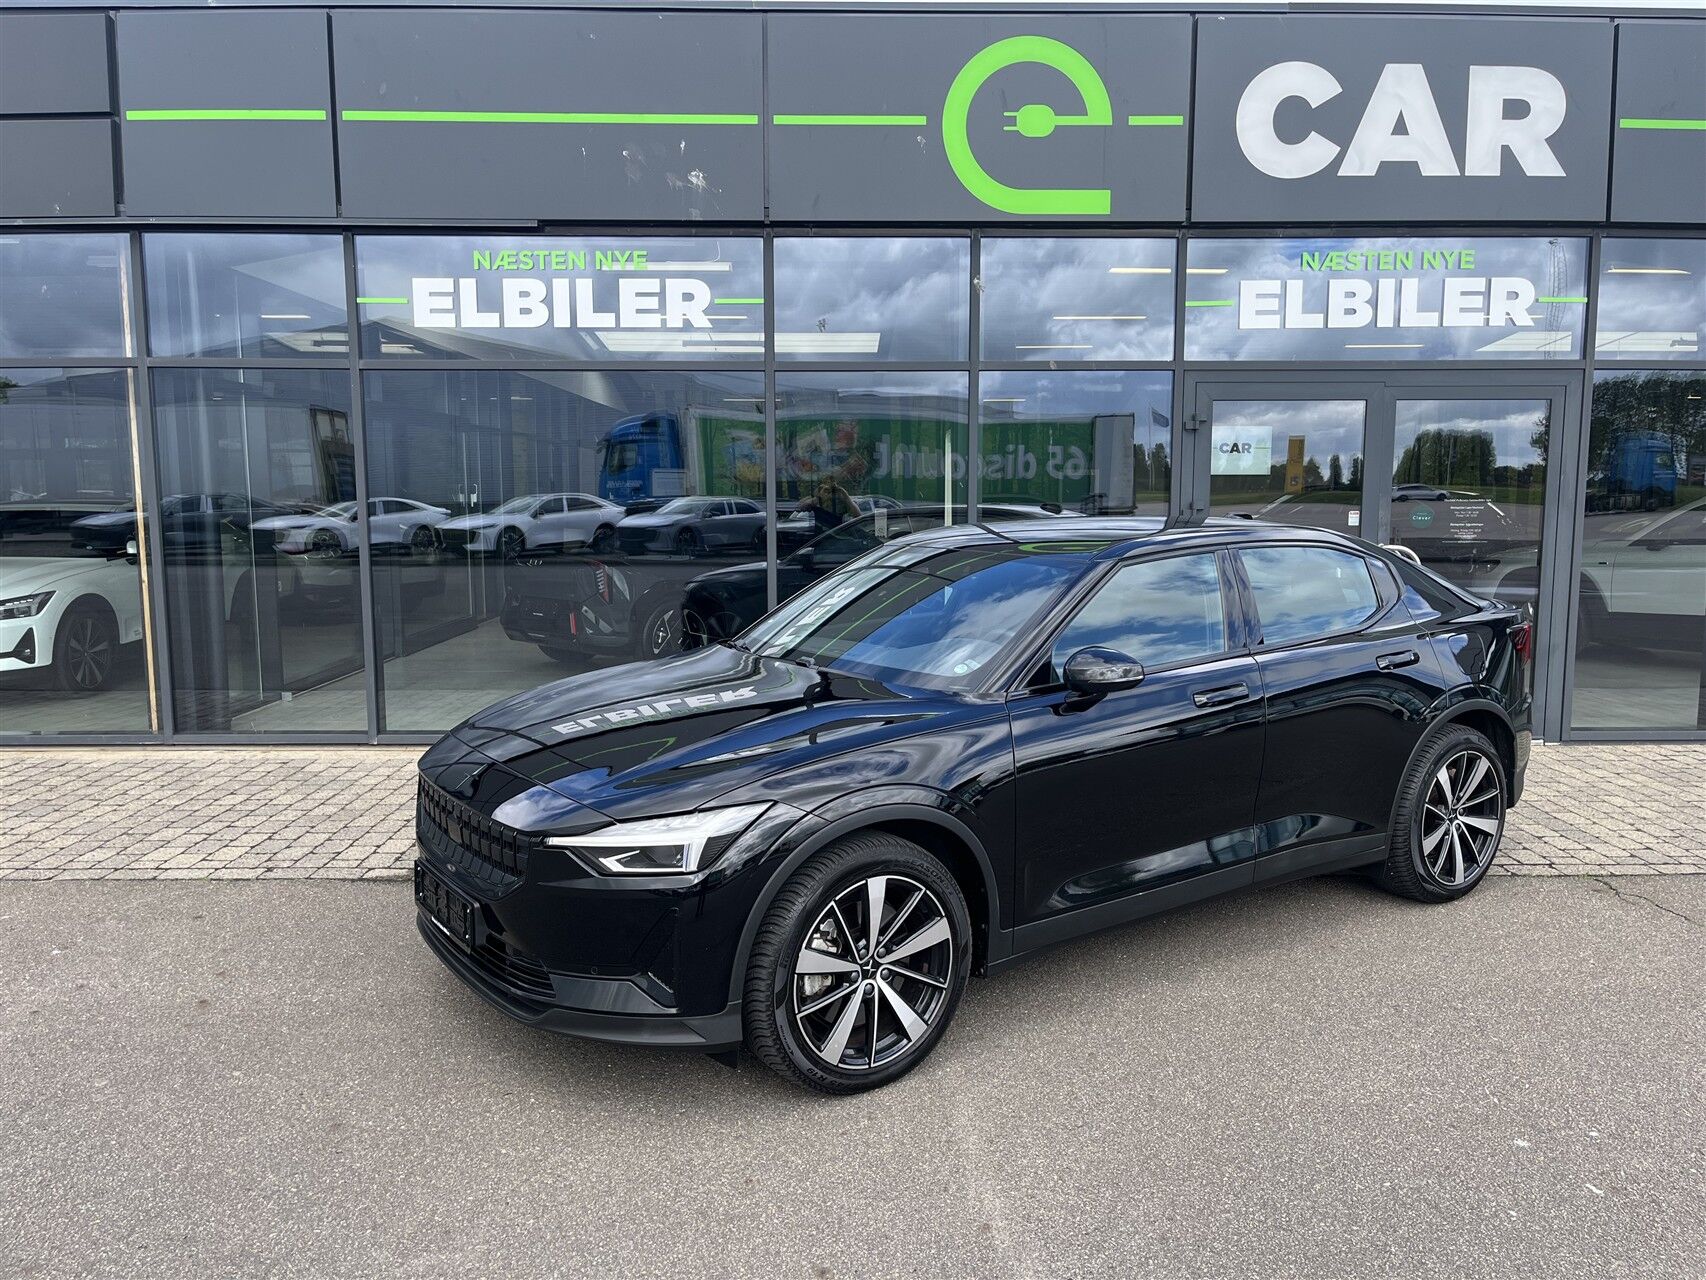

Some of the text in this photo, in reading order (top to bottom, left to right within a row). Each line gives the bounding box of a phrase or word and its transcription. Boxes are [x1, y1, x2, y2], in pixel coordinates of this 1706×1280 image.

[1236, 61, 1567, 178] CAR
[472, 249, 649, 271] NÆSTEN NYE
[1300, 249, 1476, 271] NÆSTEN NYE
[411, 277, 713, 329] ELBILER
[1238, 277, 1536, 330] ELBILER
[1218, 442, 1252, 454] CAR
